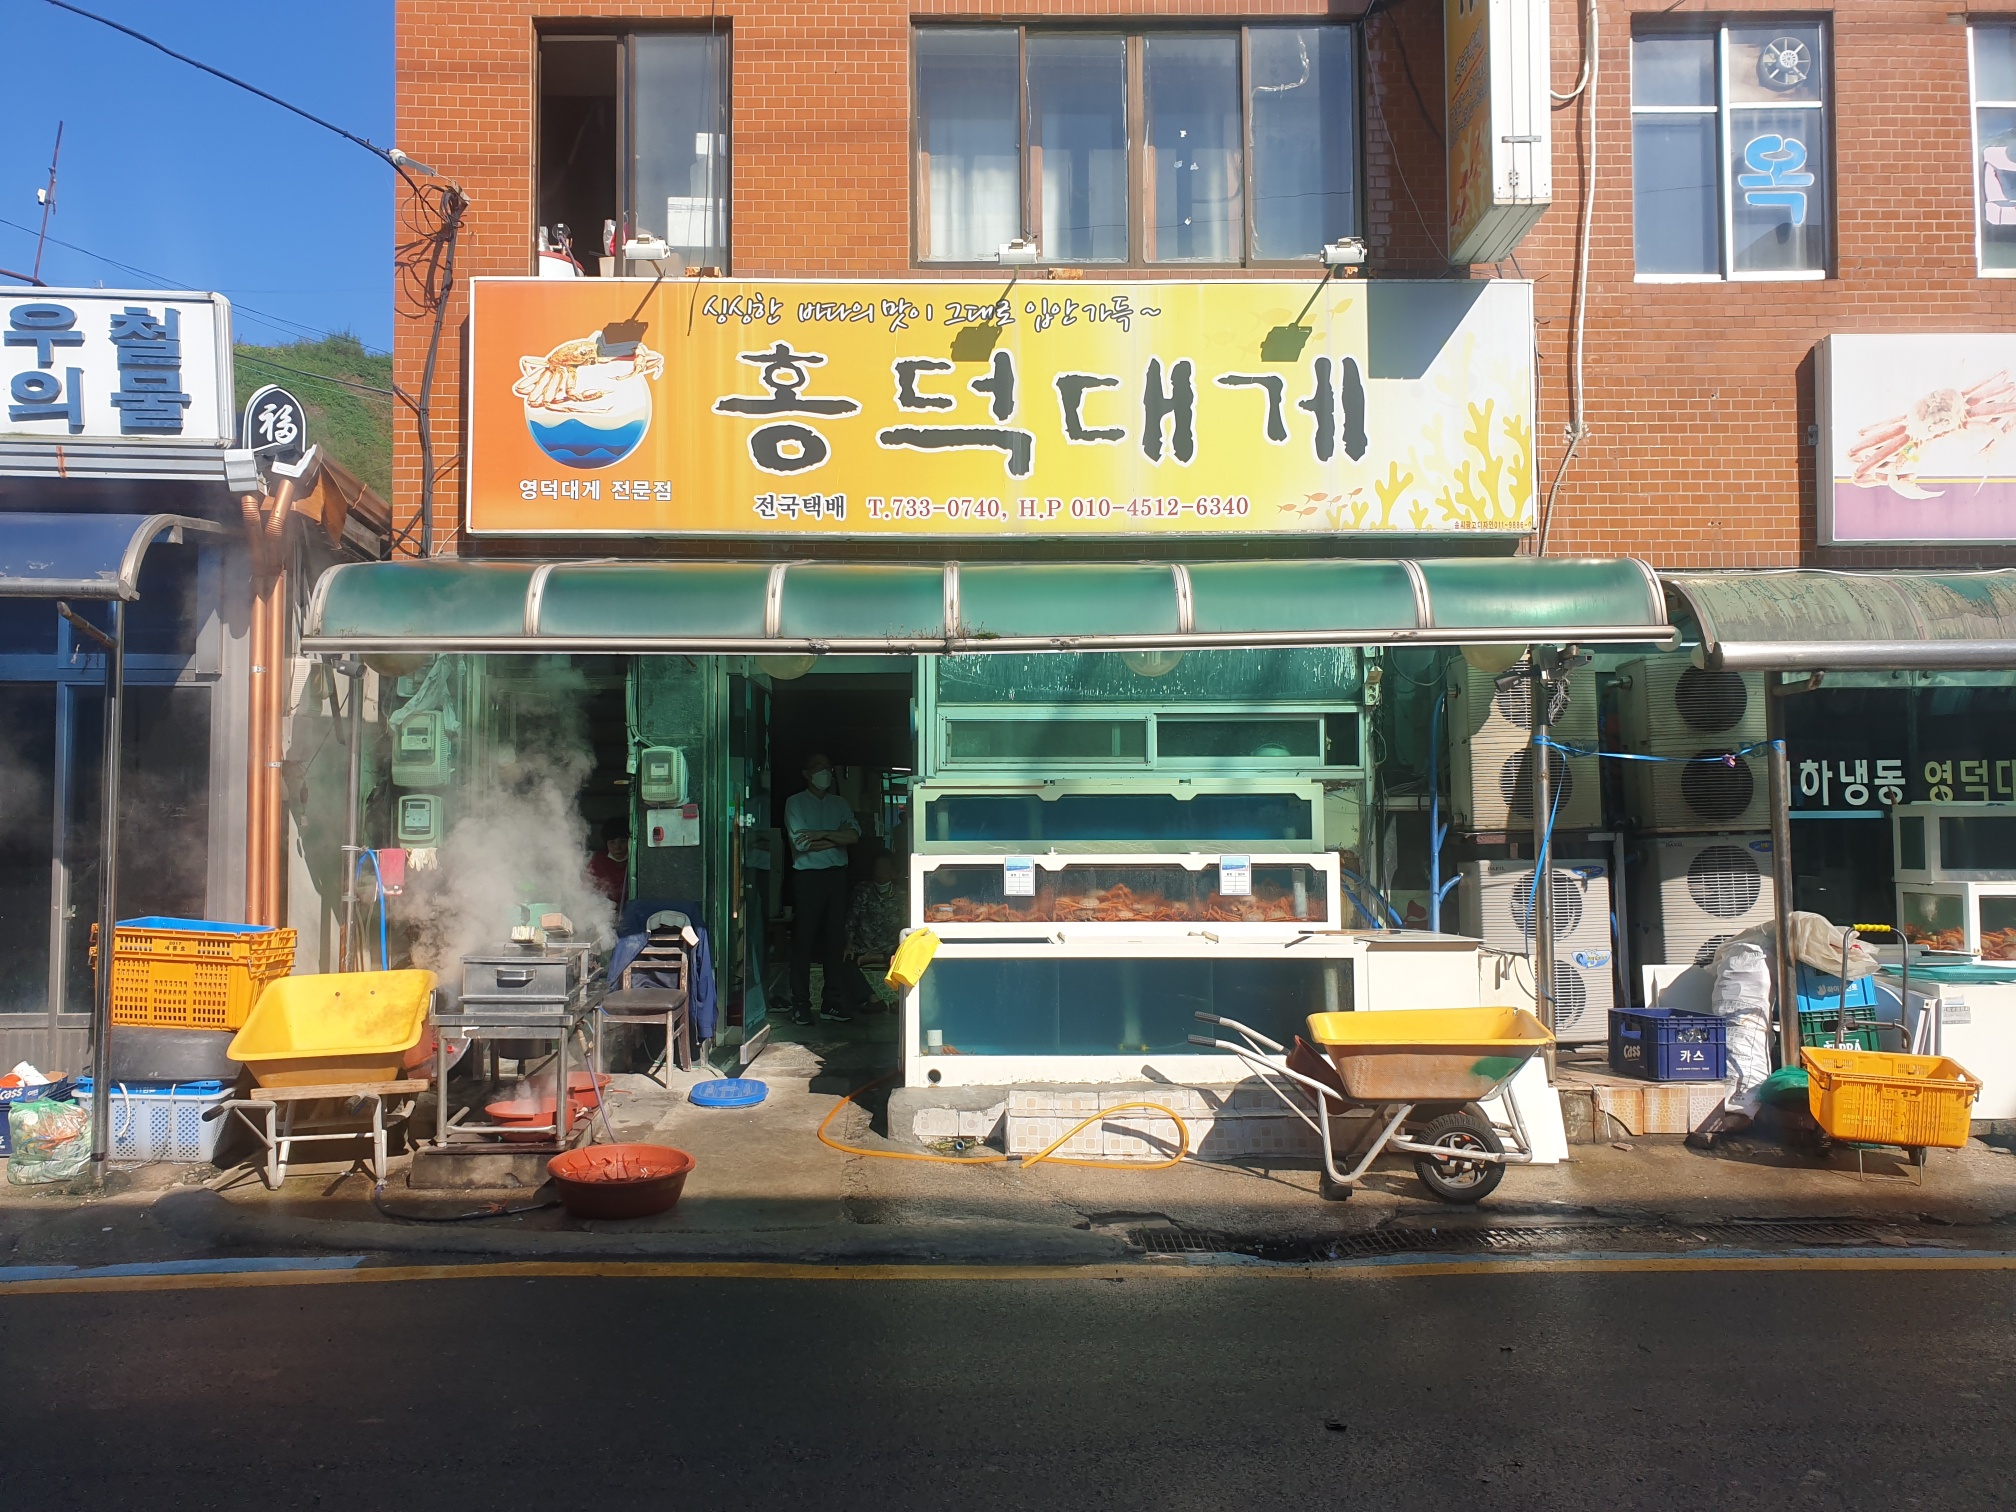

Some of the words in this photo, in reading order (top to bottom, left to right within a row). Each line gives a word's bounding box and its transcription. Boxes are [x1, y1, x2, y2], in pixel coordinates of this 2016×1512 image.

[702, 292, 784, 325] 싱싱한
[797, 301, 875, 324] 바다의
[881, 297, 933, 332] 맛이
[944, 299, 1016, 326] 그대로
[258, 403, 299, 446] 福
[712, 340, 1371, 477] 홍덕대게
[519, 479, 601, 501] 영덕대게
[610, 479, 673, 501] 전문점
[754, 493, 846, 519] 전국택배
[1018, 498, 1063, 520] H.P
[1070, 496, 1250, 518] 010-4512-6340
[1786, 759, 1907, 806] 하냉동
[1680, 1050, 1704, 1063] 카스
